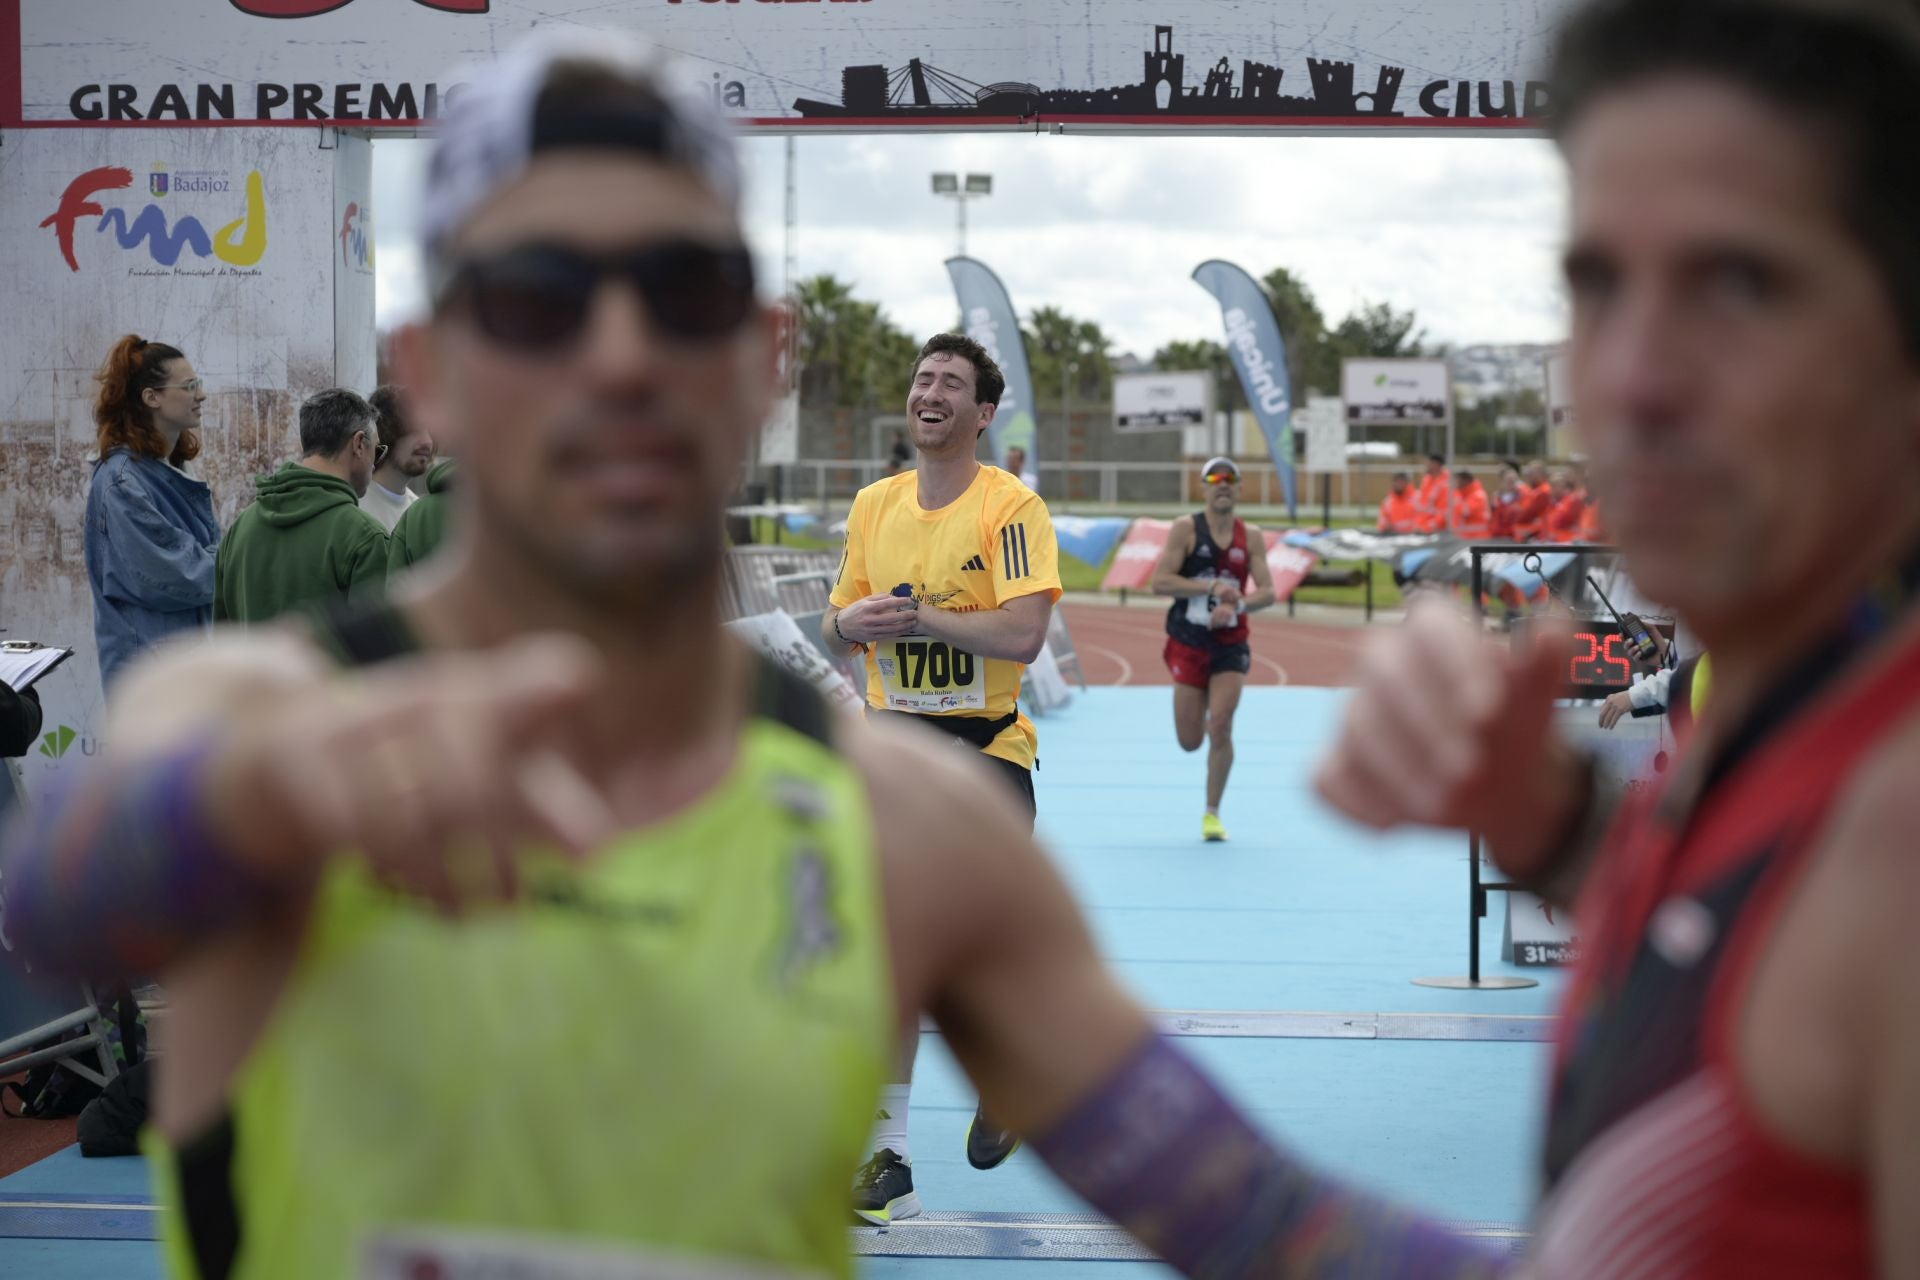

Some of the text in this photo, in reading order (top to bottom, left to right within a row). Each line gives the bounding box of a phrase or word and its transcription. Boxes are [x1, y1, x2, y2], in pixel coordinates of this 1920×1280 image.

[70, 84, 235, 120] GRAN
[174, 177, 230, 194] Badajoz
[896, 642, 974, 688] 1700
[1525, 945, 1547, 963] 31
